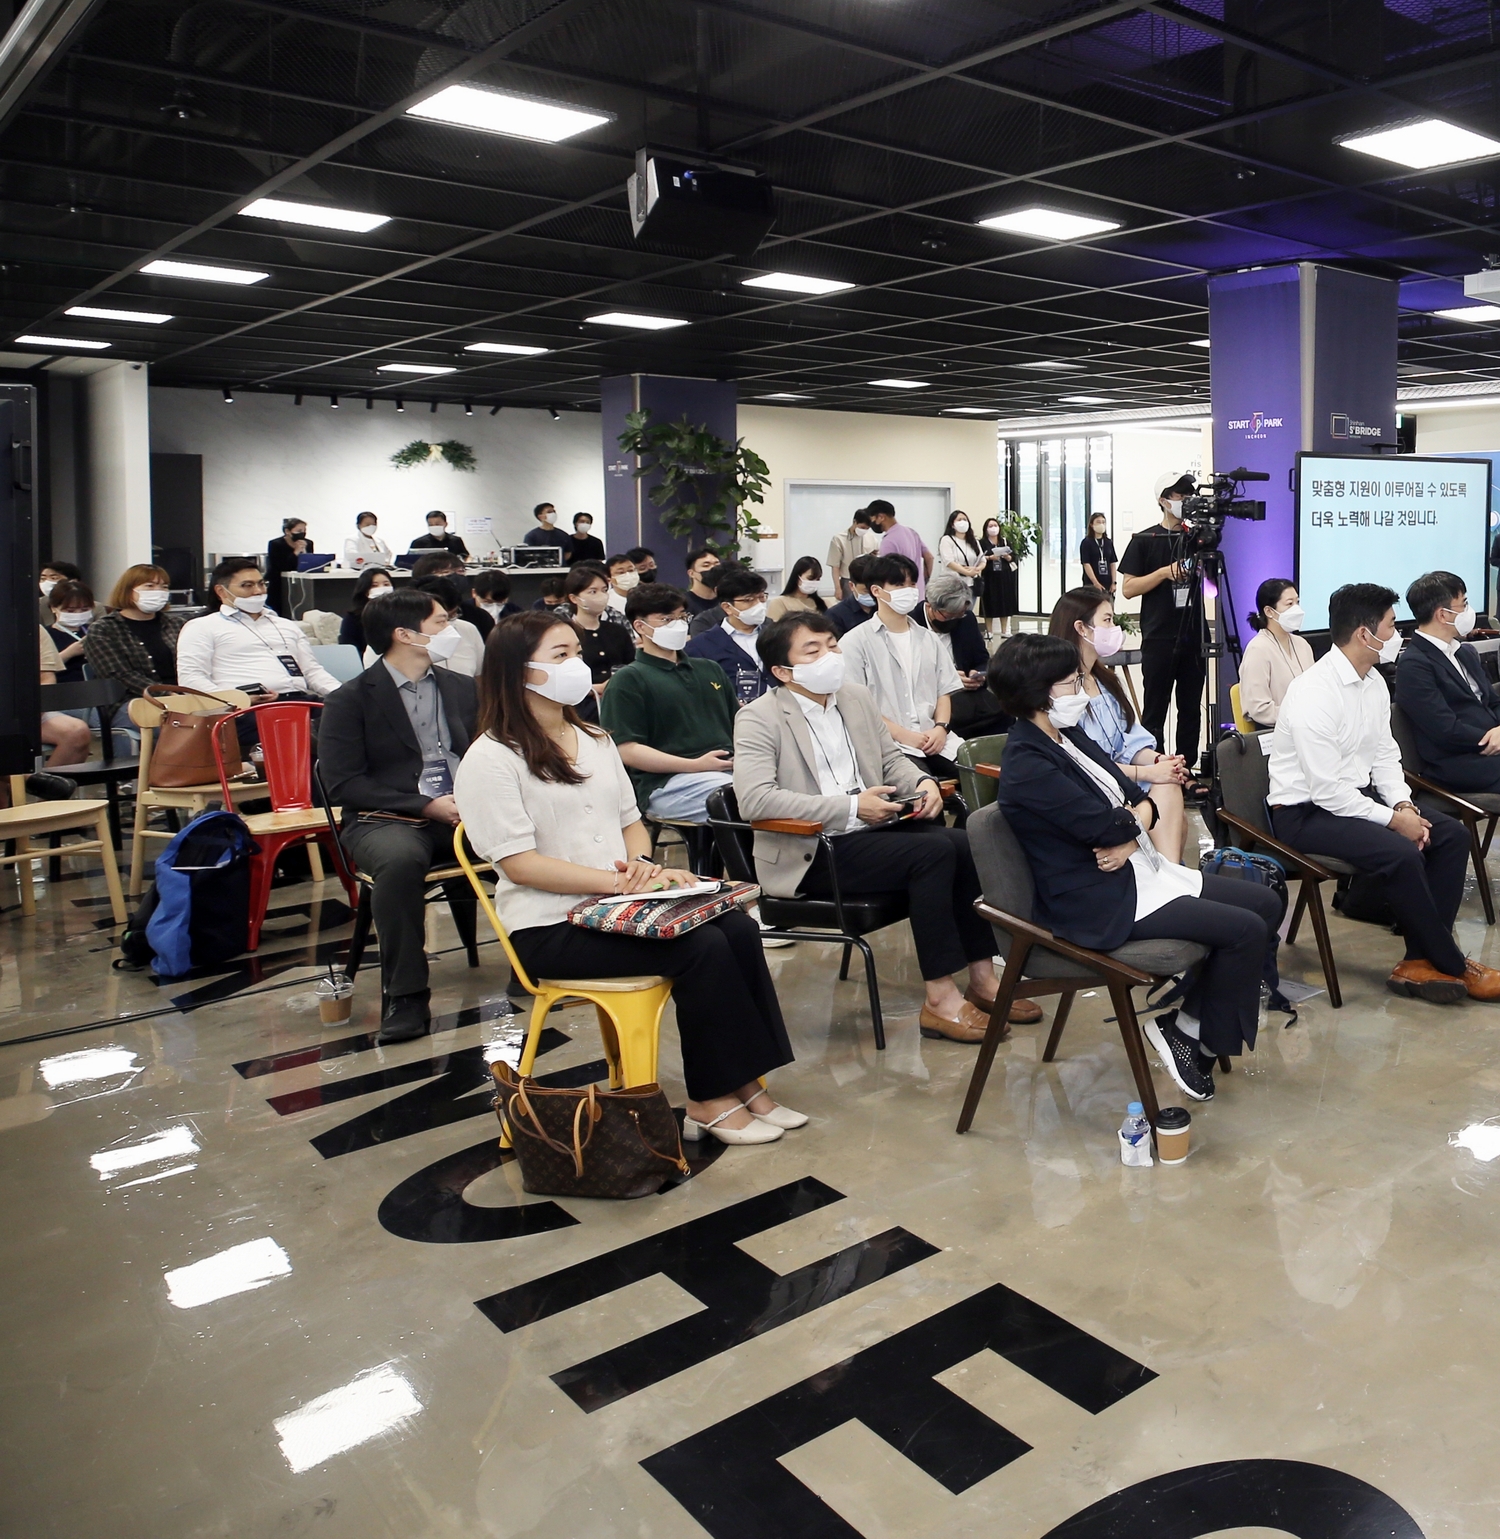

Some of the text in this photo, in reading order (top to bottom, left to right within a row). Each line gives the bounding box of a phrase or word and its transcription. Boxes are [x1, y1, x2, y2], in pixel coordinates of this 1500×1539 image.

[1228, 418, 1283, 430] START PARK
[1312, 480, 1467, 498] 맞춤형 지원이 이루어질 수 있도록
[1312, 510, 1438, 528] 더욱 노력해 나갈 것입니다.
